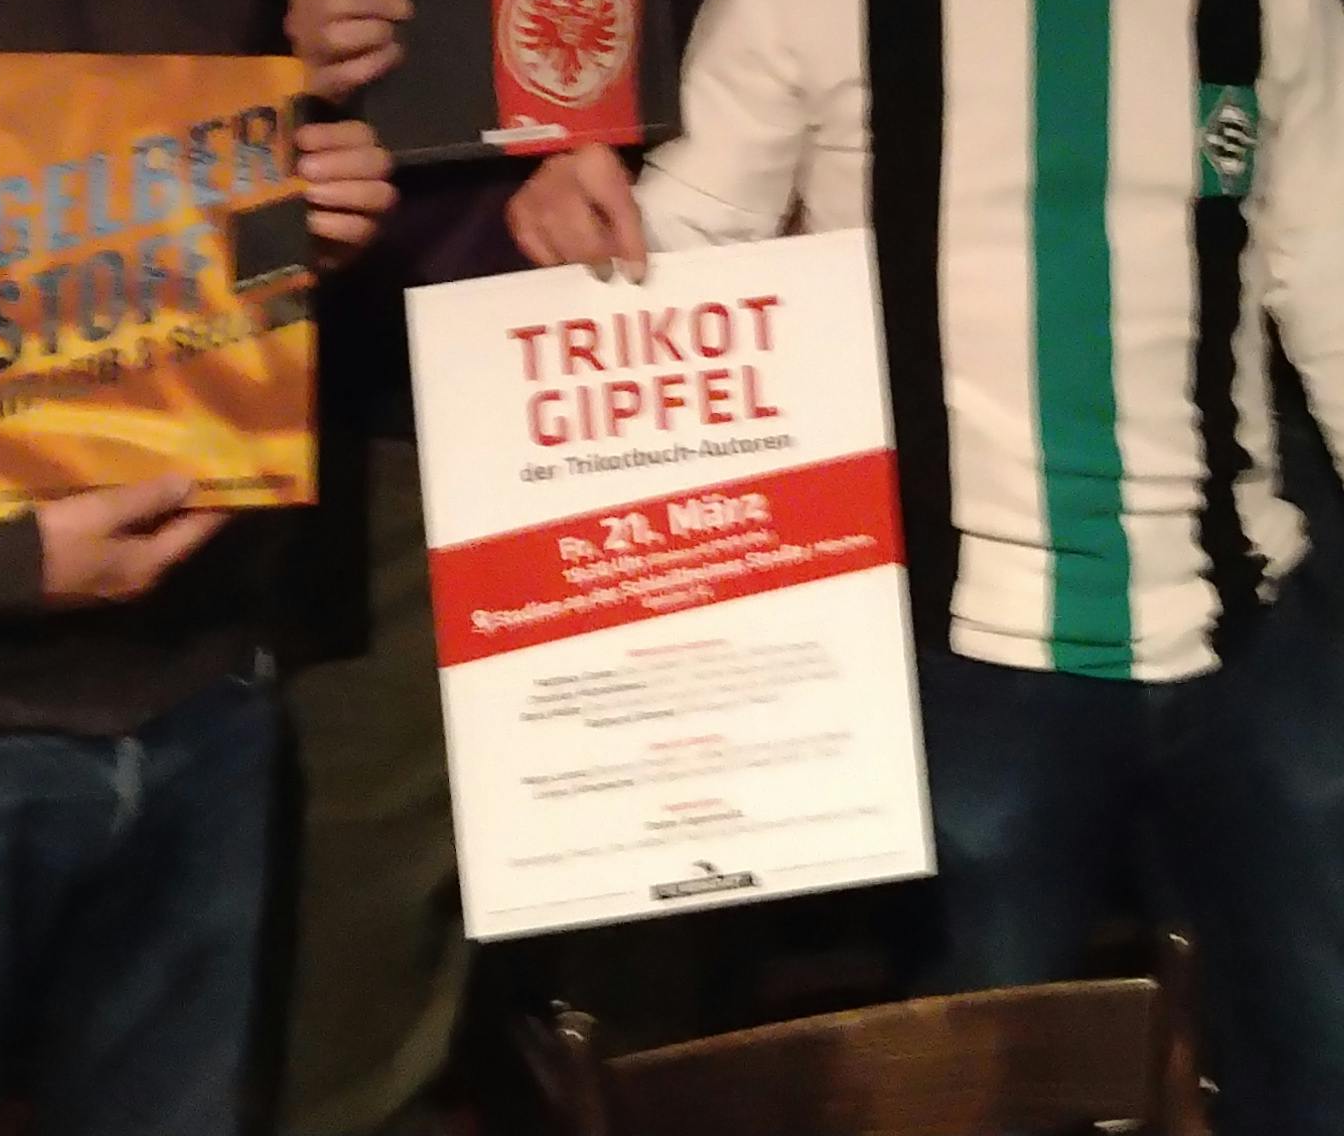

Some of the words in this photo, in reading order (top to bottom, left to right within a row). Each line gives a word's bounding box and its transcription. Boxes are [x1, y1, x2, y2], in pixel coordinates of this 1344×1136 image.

[507, 295, 781, 381] TRIKOT
[527, 365, 782, 447] GIPFEL
[519, 461, 558, 483] der
[564, 432, 793, 477] Trikotbuch-Autoren
[666, 492, 773, 539] März
